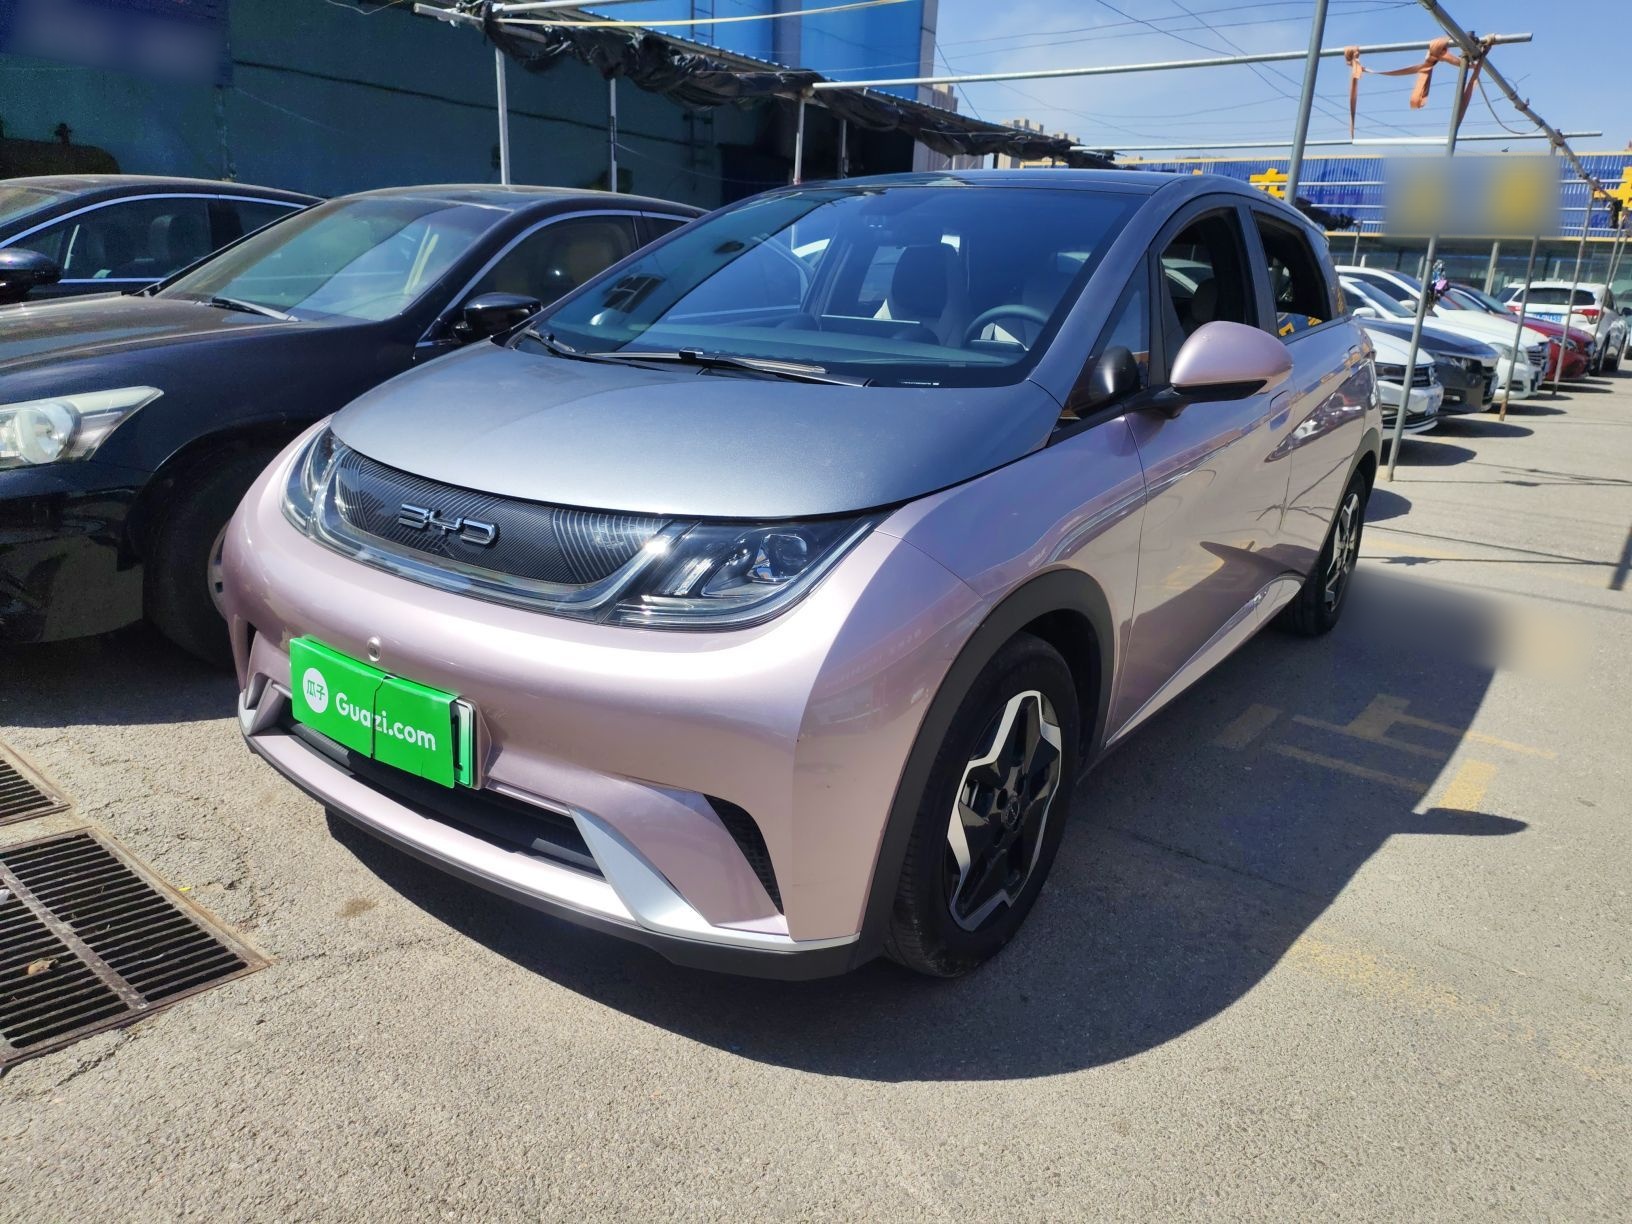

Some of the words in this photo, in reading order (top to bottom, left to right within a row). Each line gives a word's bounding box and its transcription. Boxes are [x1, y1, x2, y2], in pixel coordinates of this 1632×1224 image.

[399, 503, 496, 545] BYD
[306, 679, 326, 701] 瓜子
[335, 692, 437, 751] Guazi.com
